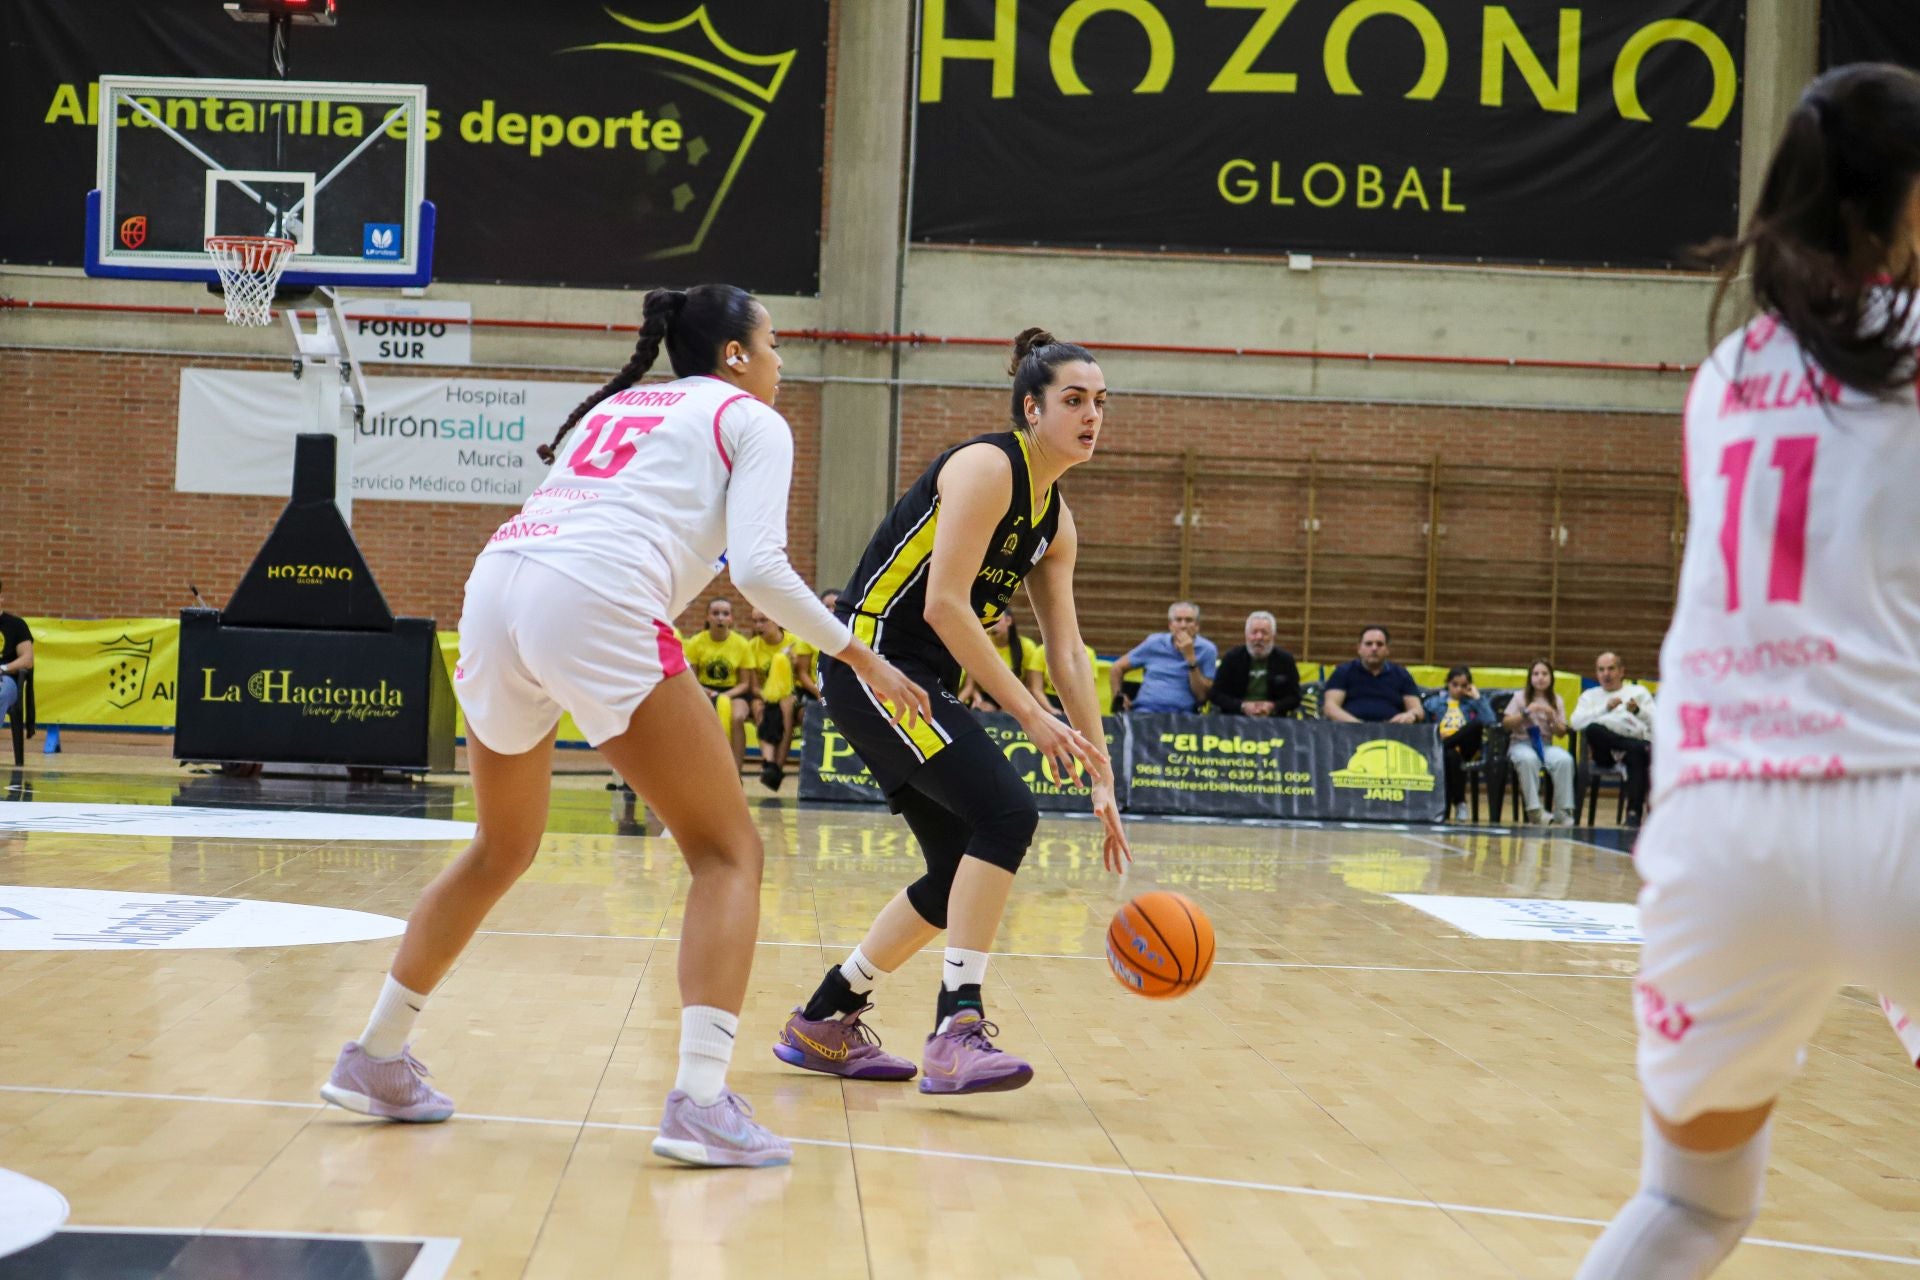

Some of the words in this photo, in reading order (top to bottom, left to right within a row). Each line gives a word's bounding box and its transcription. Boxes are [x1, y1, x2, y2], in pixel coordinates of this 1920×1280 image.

[919, 0, 1738, 129] HOZONO
[460, 100, 683, 157] deporte
[1217, 158, 1467, 212] GLOBAL
[358, 320, 447, 338] FONDO
[379, 340, 425, 359] SUR
[446, 386, 526, 408] Hospital
[608, 391, 687, 407] MORRO
[354, 411, 526, 443] uirónsalud
[567, 413, 665, 479] 15
[458, 450, 524, 469] Murcia
[352, 475, 404, 492] ervicio
[409, 476, 466, 494] Médico
[471, 477, 522, 495] Oficial
[1718, 434, 1819, 613] 11
[267, 565, 353, 581] HOZONO
[201, 668, 241, 702] La
[259, 669, 404, 707] Hacienda
[1193, 767, 1218, 779] 140
[1262, 758, 1279, 769] 14
[1362, 788, 1405, 802] JARB
